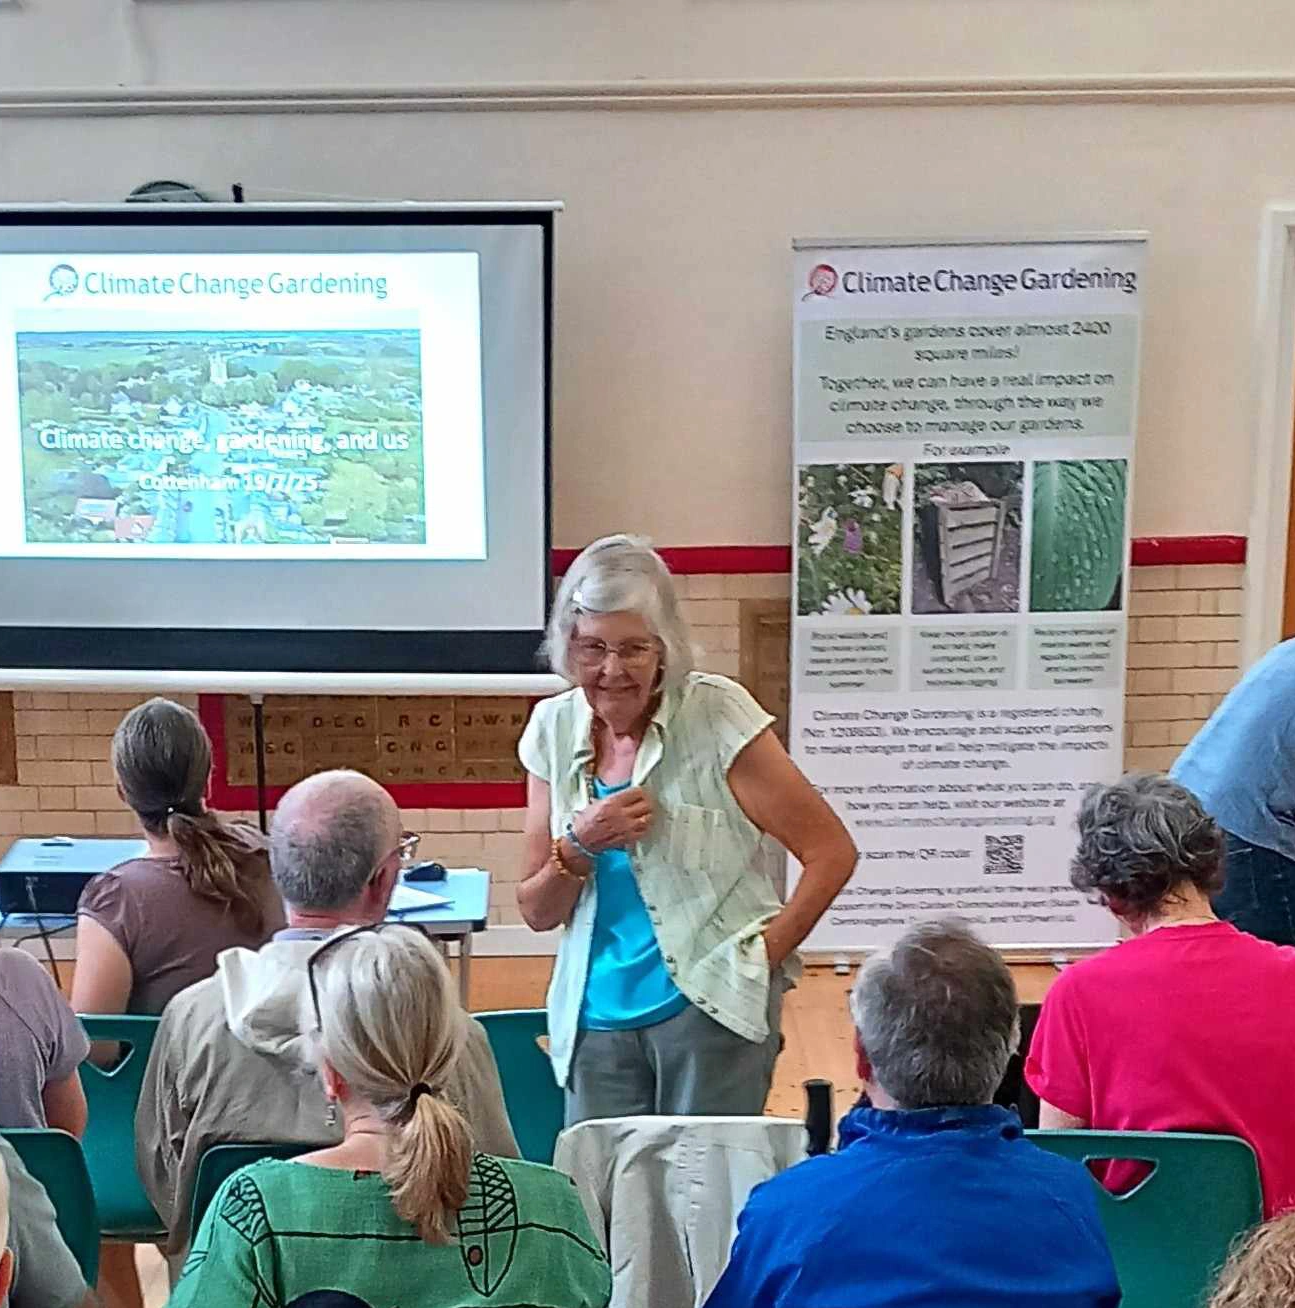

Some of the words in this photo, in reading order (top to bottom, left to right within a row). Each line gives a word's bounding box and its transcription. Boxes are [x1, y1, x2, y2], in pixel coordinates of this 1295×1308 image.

[84, 272, 175, 294] Climate
[179, 272, 264, 299] Change
[268, 272, 388, 299] Gardening
[842, 271, 931, 293] Climate
[934, 269, 1018, 296] Change
[1020, 267, 1137, 292] Gardening
[825, 326, 900, 343] England's
[903, 325, 965, 341] gardens
[968, 326, 1011, 337] cover
[1014, 322, 1071, 336] almost
[914, 349, 968, 362] square
[892, 377, 914, 389] we
[917, 377, 947, 388] can
[949, 374, 986, 387] have
[990, 376, 999, 387] a
[1003, 373, 1033, 386] real
[1035, 372, 1090, 388] impact
[1093, 374, 1114, 385] on
[829, 399, 887, 412] climate
[953, 394, 1015, 412] through
[1017, 395, 1044, 408] the
[1046, 397, 1076, 410] way
[1081, 396, 1104, 408] we
[846, 421, 902, 433] choose
[905, 421, 922, 432] to
[925, 420, 986, 434] manage
[990, 420, 1016, 431] our
[39, 427, 125, 450] Climate
[335, 428, 380, 450] and
[382, 431, 409, 449] us
[138, 473, 238, 492] Cottenham
